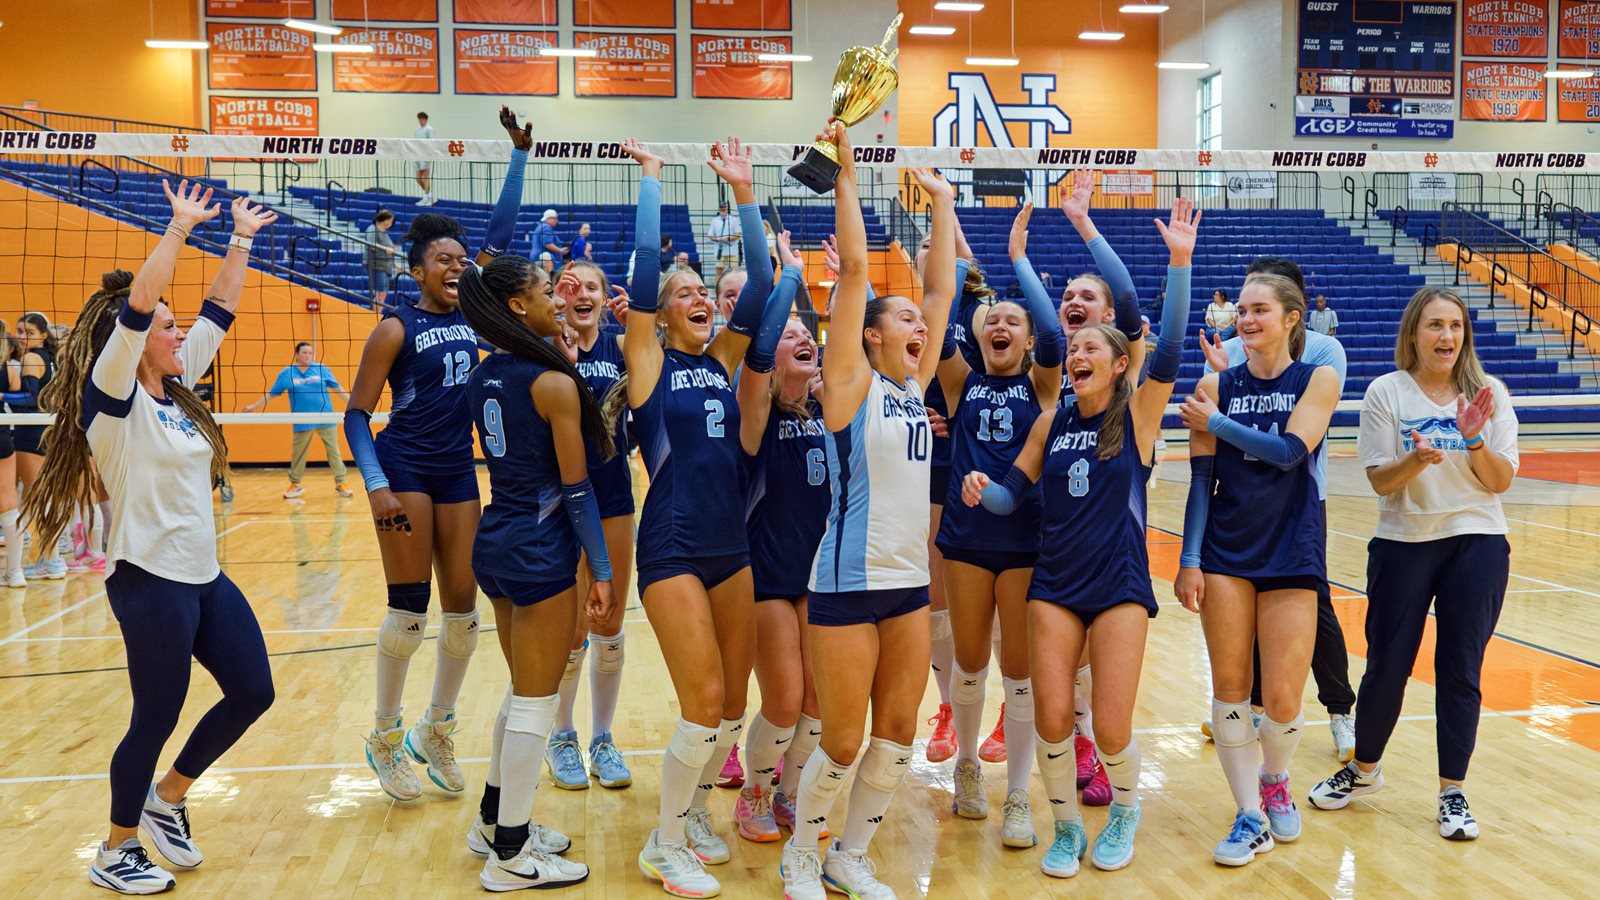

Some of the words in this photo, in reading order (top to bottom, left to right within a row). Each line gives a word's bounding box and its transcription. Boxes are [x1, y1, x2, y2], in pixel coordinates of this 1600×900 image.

[1307, 2, 1339, 12] GUEST
[1412, 5, 1452, 15] WARRIORS
[1468, 1, 1509, 17] NORTH
[1514, 2, 1543, 18] COBB
[1478, 11, 1499, 22] BOYS
[1502, 11, 1534, 23] TENNIS
[213, 27, 266, 46] NORTH
[271, 28, 310, 47] COBB
[1356, 28, 1382, 36] PERIOD
[1467, 24, 1494, 37] STATE
[1496, 25, 1544, 37] CHAMPIONS
[1563, 27, 1589, 39] STATE
[226, 39, 297, 52] VOLLEYBALL
[339, 31, 390, 45] NORTH
[395, 31, 433, 50] COBB
[370, 42, 420, 55] OTBALL
[460, 33, 510, 52] NORTH
[515, 34, 552, 51] COBB
[580, 36, 628, 50] NORTH
[634, 37, 670, 55] COBB
[697, 38, 746, 54] NORTH
[751, 39, 786, 55] COBB
[1492, 38, 1519, 52] 1970
[471, 45, 501, 57] GIRLS
[503, 45, 541, 58] TENNIS
[705, 52, 727, 63] BOYS
[1467, 65, 1508, 81] NORTH
[1513, 65, 1543, 82] COBB
[1476, 76, 1500, 87] GIRLS
[1503, 76, 1533, 87] TENNIS
[1320, 75, 1351, 93] HOME
[1352, 76, 1367, 93] OF
[1368, 77, 1391, 93] THE
[1393, 78, 1451, 95] WARRIORS
[1314, 98, 1333, 107] DAYS
[1466, 88, 1493, 101] STATE
[1495, 89, 1543, 101] CHAMPIONS
[1561, 90, 1587, 102] STATE
[216, 100, 268, 116] NORTH
[274, 100, 313, 117] COBB
[1492, 102, 1519, 117] 1983
[229, 113, 300, 126] SOFTBALL
[0, 131, 40, 149] RTH
[45, 132, 97, 150] COBB
[262, 137, 323, 155] NORTH
[328, 138, 377, 156] COBB
[534, 142, 596, 159] NORTH
[597, 143, 635, 159] COB
[853, 147, 897, 163] COBB
[1037, 149, 1092, 165] NORTH
[1094, 150, 1137, 166] COBB
[1272, 151, 1322, 167] NORTH
[1326, 152, 1367, 168] COBB
[1495, 153, 1545, 168] NORTH
[1546, 153, 1586, 168] COBB
[1108, 175, 1147, 184] STUDENT
[442, 350, 471, 387] 12
[704, 399, 725, 438] 2
[976, 406, 1013, 442] 13
[483, 398, 507, 458] 9
[905, 421, 928, 461] 10
[806, 447, 826, 486] 6
[1067, 457, 1090, 497] 8
